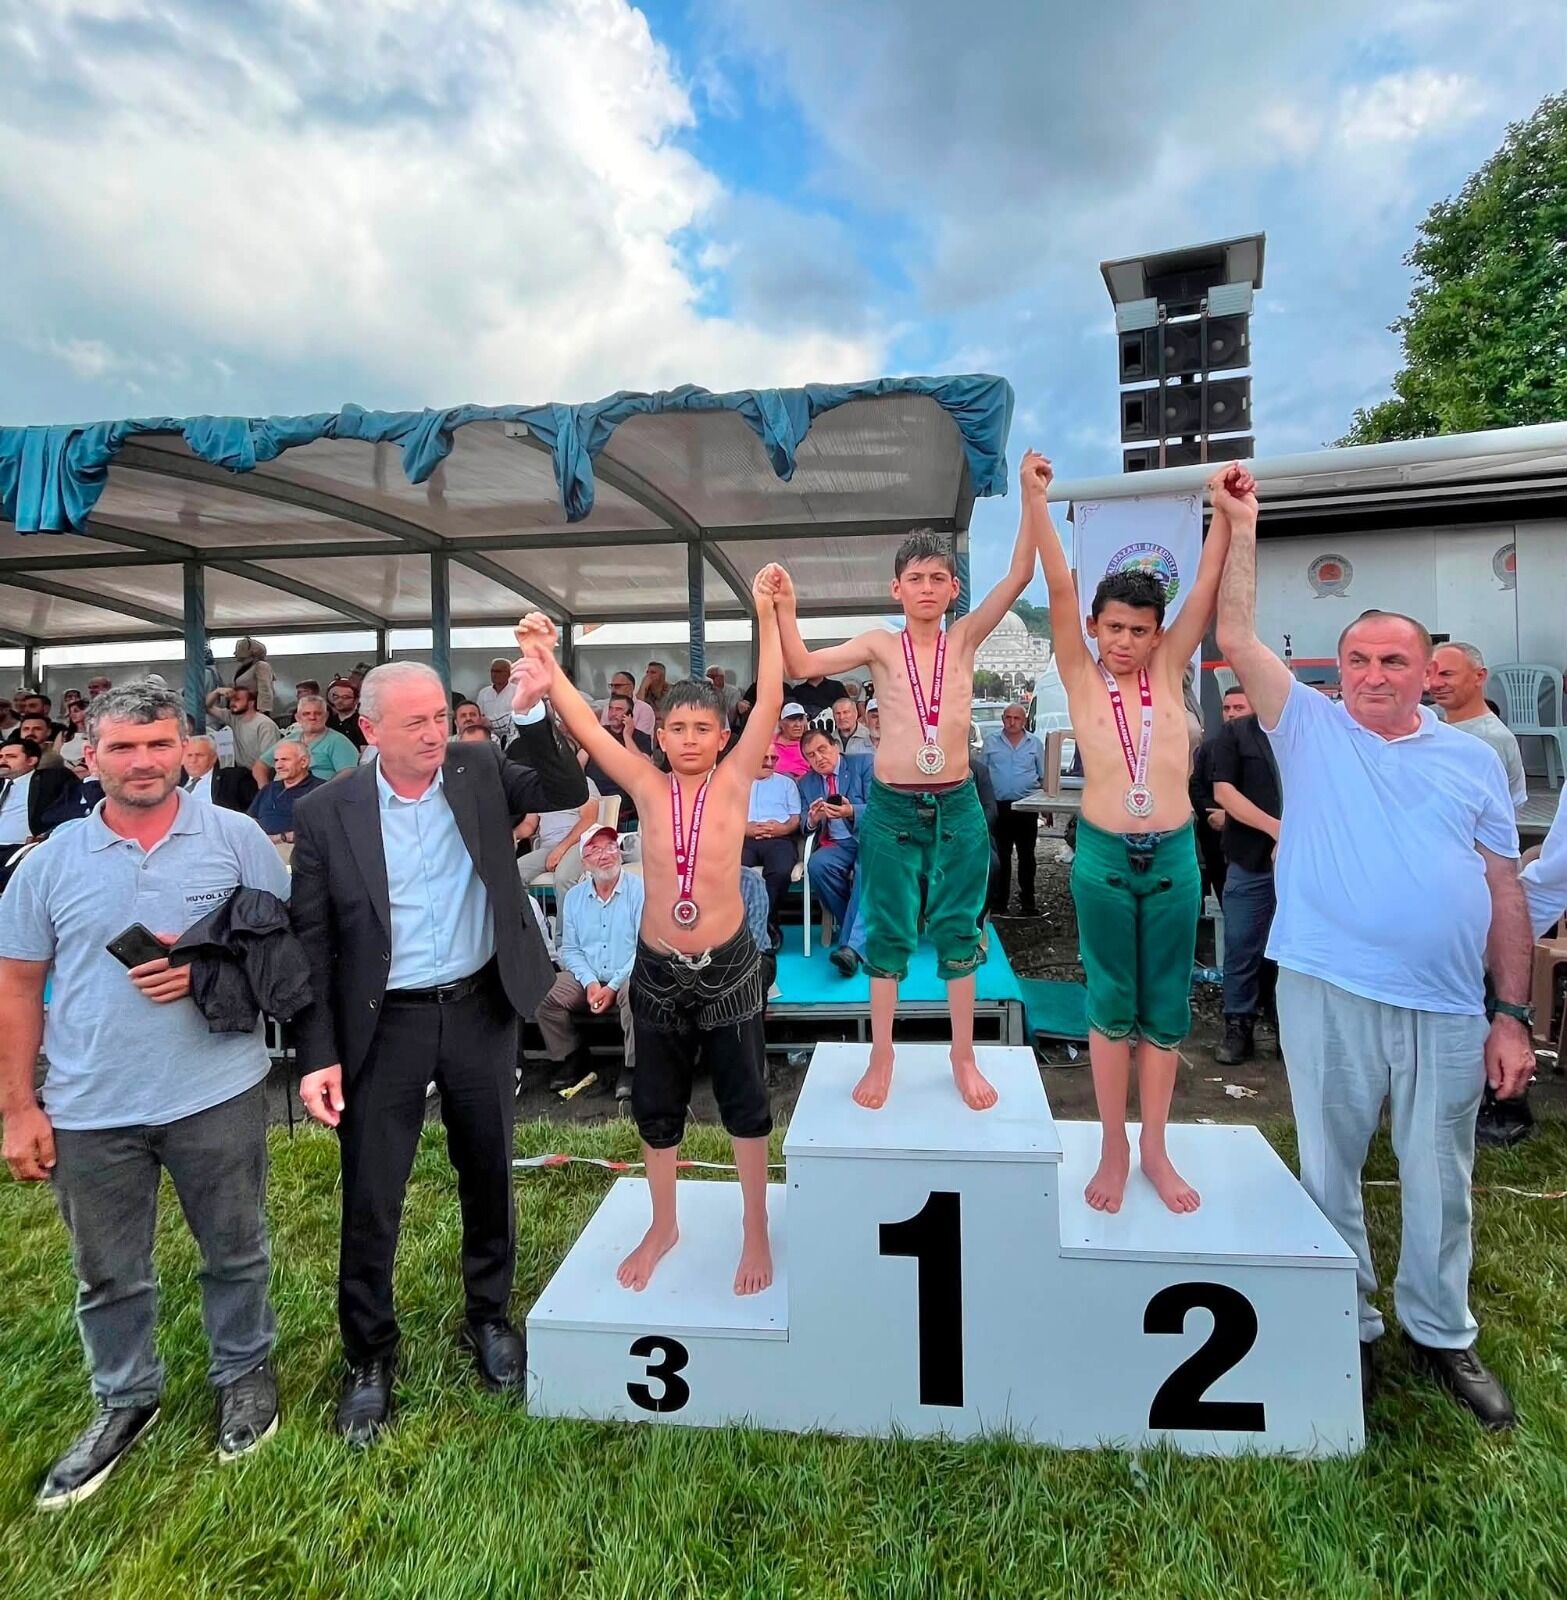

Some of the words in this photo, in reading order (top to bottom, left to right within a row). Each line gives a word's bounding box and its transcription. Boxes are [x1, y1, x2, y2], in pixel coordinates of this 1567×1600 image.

[1106, 543, 1141, 575] ALIPAZARI
[878, 1191, 964, 1408] 1
[1143, 1281, 1266, 1432] 2
[626, 1335, 690, 1413] 3
